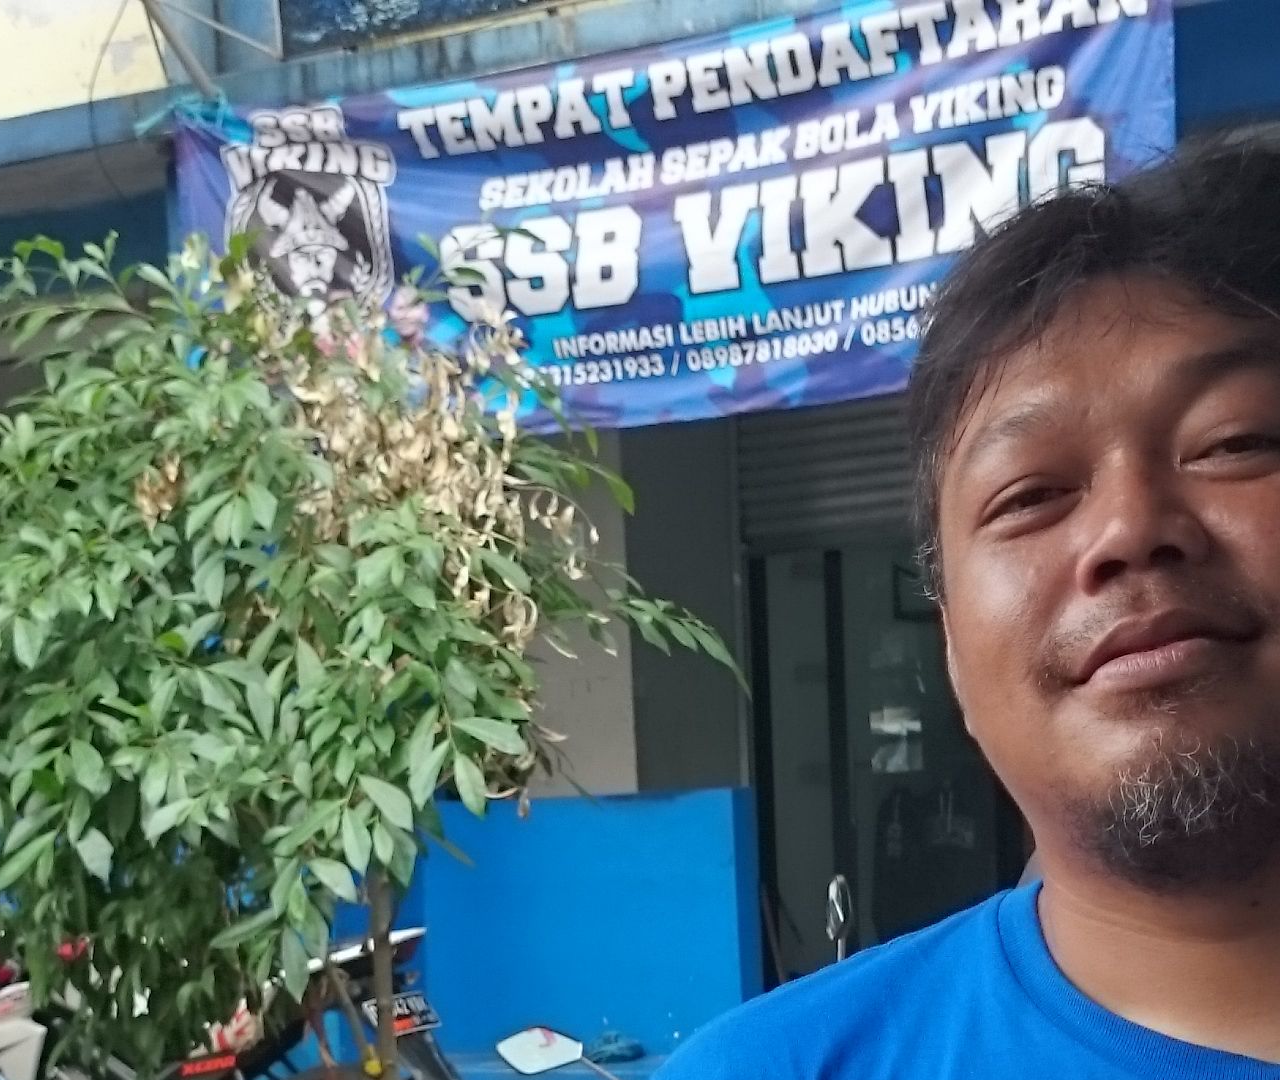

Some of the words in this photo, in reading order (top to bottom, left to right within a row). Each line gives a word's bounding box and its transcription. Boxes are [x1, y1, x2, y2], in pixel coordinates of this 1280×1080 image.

[251, 107, 345, 149] SSB
[396, 68, 635, 160] TEMPAT
[479, 151, 656, 211] SEKOLAH
[660, 126, 792, 186] SEPAK
[792, 102, 900, 160] BOLA
[909, 65, 1066, 135] VIKING
[225, 141, 395, 192] VIKING
[439, 204, 643, 323] SSB
[673, 116, 1107, 297] VIKING
[552, 322, 675, 360] INFORMASI
[679, 314, 748, 346] LEBIH
[751, 299, 847, 337] LANJUT
[850, 281, 937, 321] HUBUN
[860, 314, 922, 347] 0856
